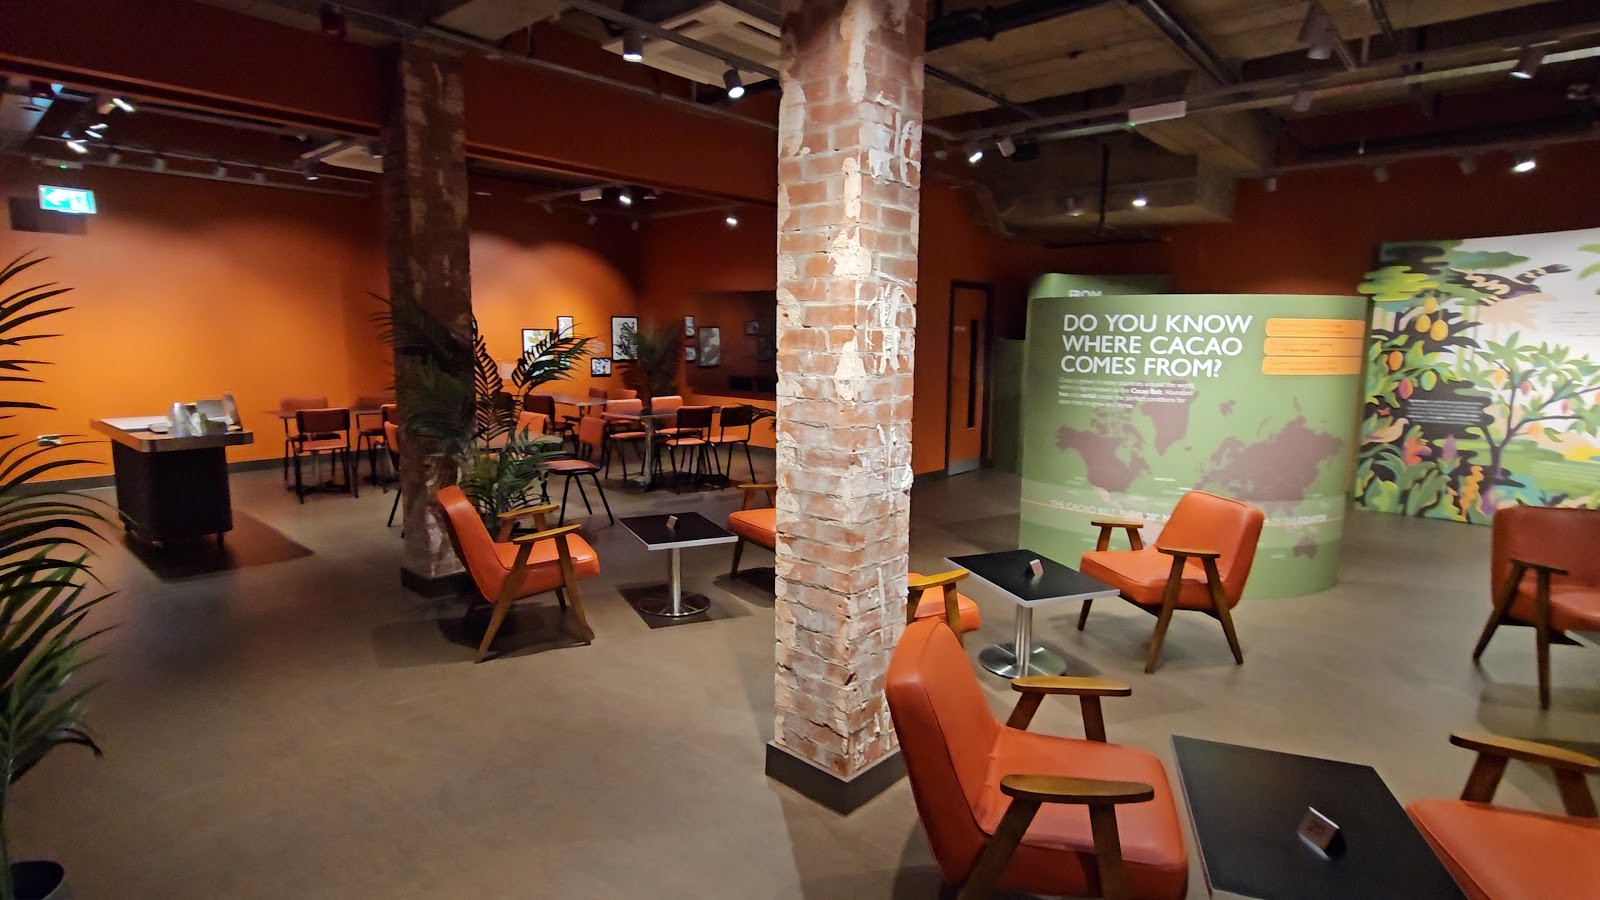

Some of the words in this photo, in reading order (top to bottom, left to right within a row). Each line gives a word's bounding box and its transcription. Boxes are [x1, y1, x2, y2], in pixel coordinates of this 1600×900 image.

[1063, 314, 1098, 332] DO
[1105, 314, 1158, 333] YOU
[1166, 314, 1253, 334] KNOW
[1062, 335, 1142, 354] WHERE
[1149, 336, 1243, 356] CACAO
[1061, 355, 1136, 375] COMES
[1144, 358, 1223, 378] FROM?
